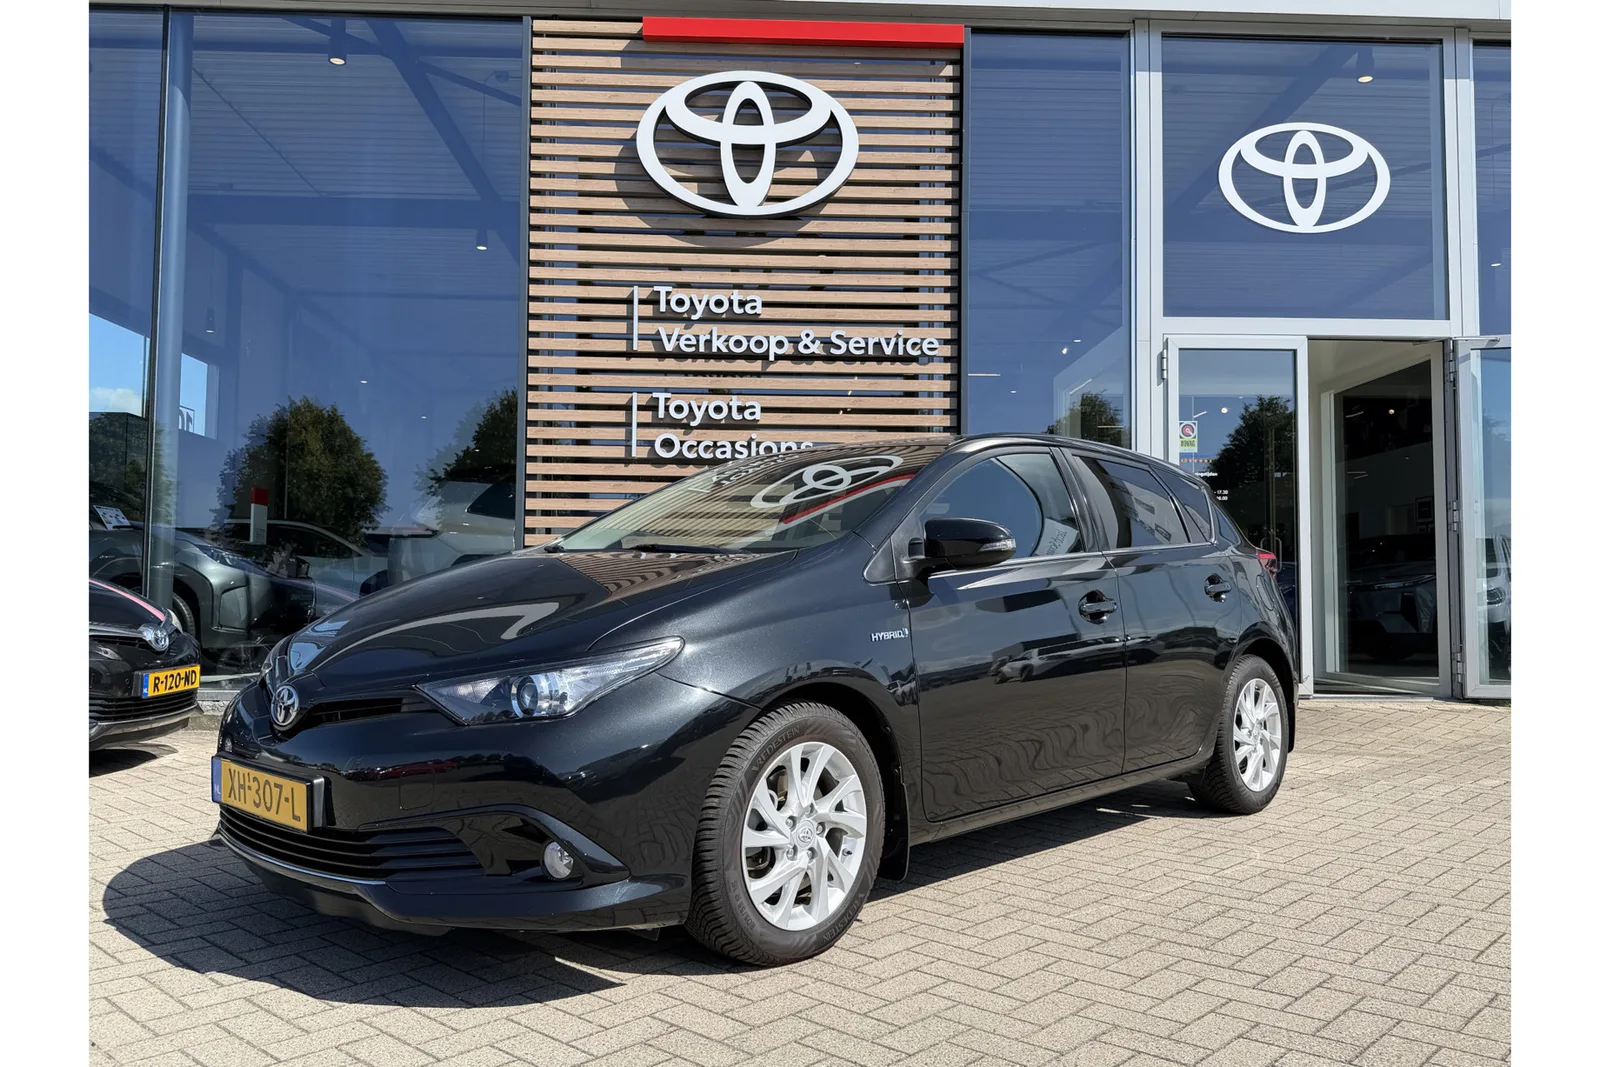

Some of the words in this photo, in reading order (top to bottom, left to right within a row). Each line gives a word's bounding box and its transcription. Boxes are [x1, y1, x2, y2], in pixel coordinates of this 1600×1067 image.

[653, 285, 763, 320] Toyota
[657, 326, 789, 361] Verkoop
[797, 329, 821, 355] &
[829, 329, 939, 356] Service
[652, 392, 761, 427] Toyota
[871, 630, 904, 642] HYBRID
[153, 669, 197, 693] R-120-ND
